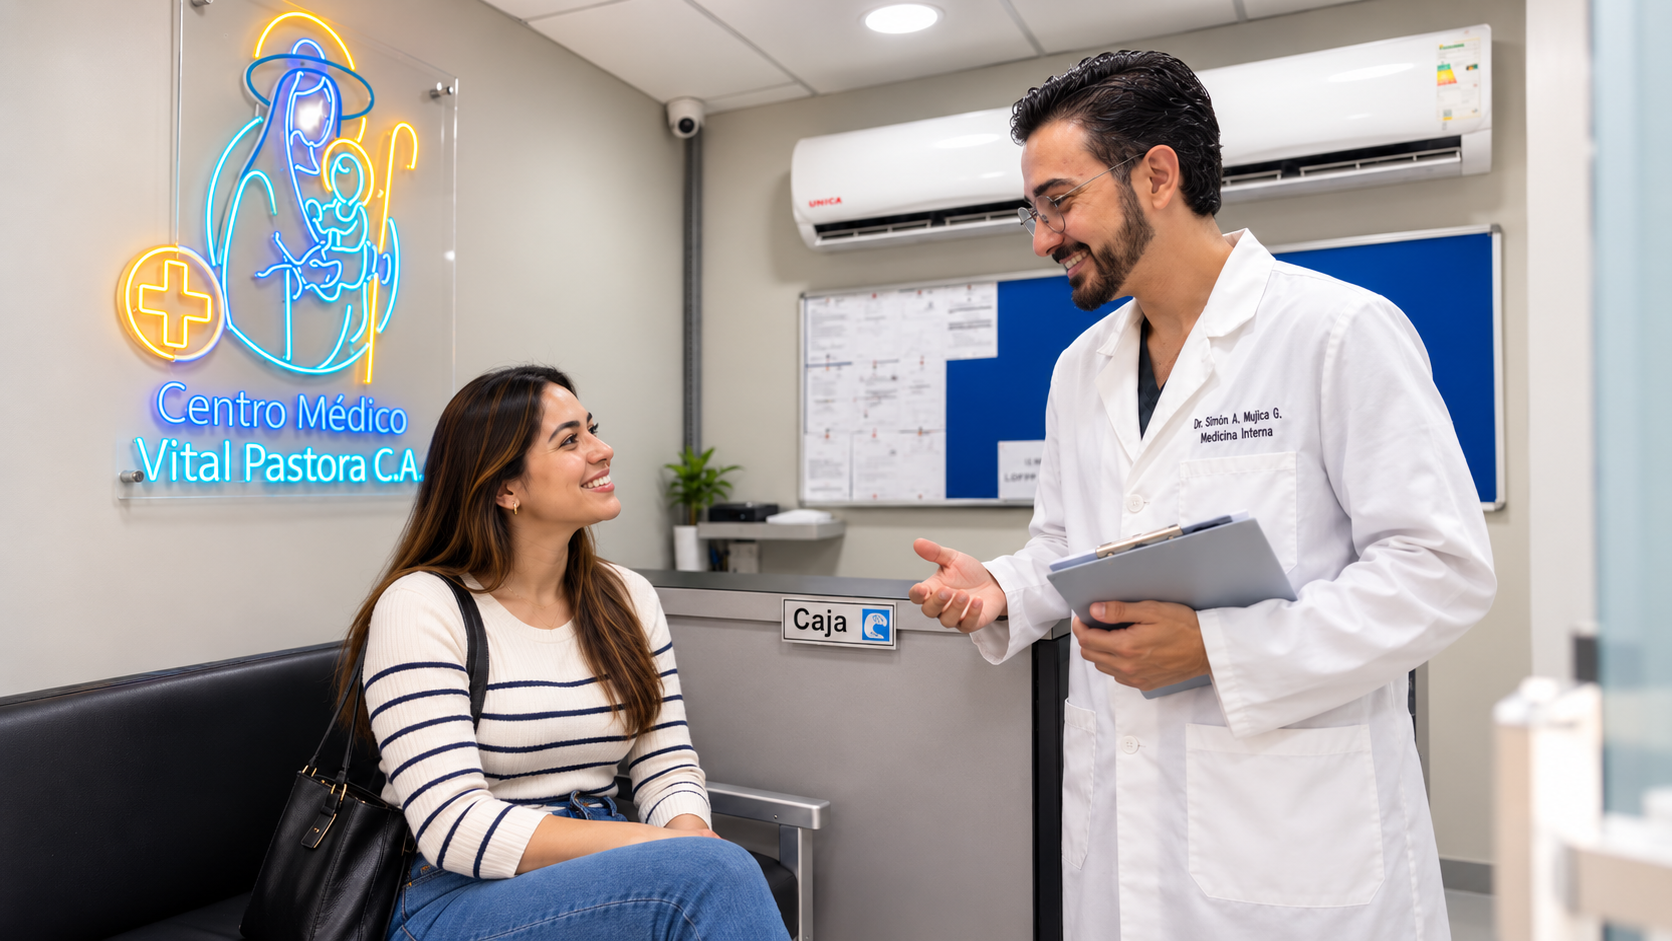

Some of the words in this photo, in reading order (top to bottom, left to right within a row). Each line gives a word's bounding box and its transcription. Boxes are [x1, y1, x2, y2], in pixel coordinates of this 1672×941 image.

[156, 381, 287, 429] Centro
[297, 393, 408, 434] Médico
[1194, 418, 1204, 429] Dr.
[1205, 414, 1229, 427] Simón
[1231, 412, 1240, 425] A.
[1243, 410, 1270, 424] Mujica
[1272, 407, 1282, 419] G.
[1200, 430, 1238, 443] Medicina
[1241, 427, 1273, 439] Interna
[133, 436, 232, 483] Vital
[243, 441, 367, 483] Pastora
[372, 447, 424, 483] C.A.
[793, 607, 848, 638] Caja
